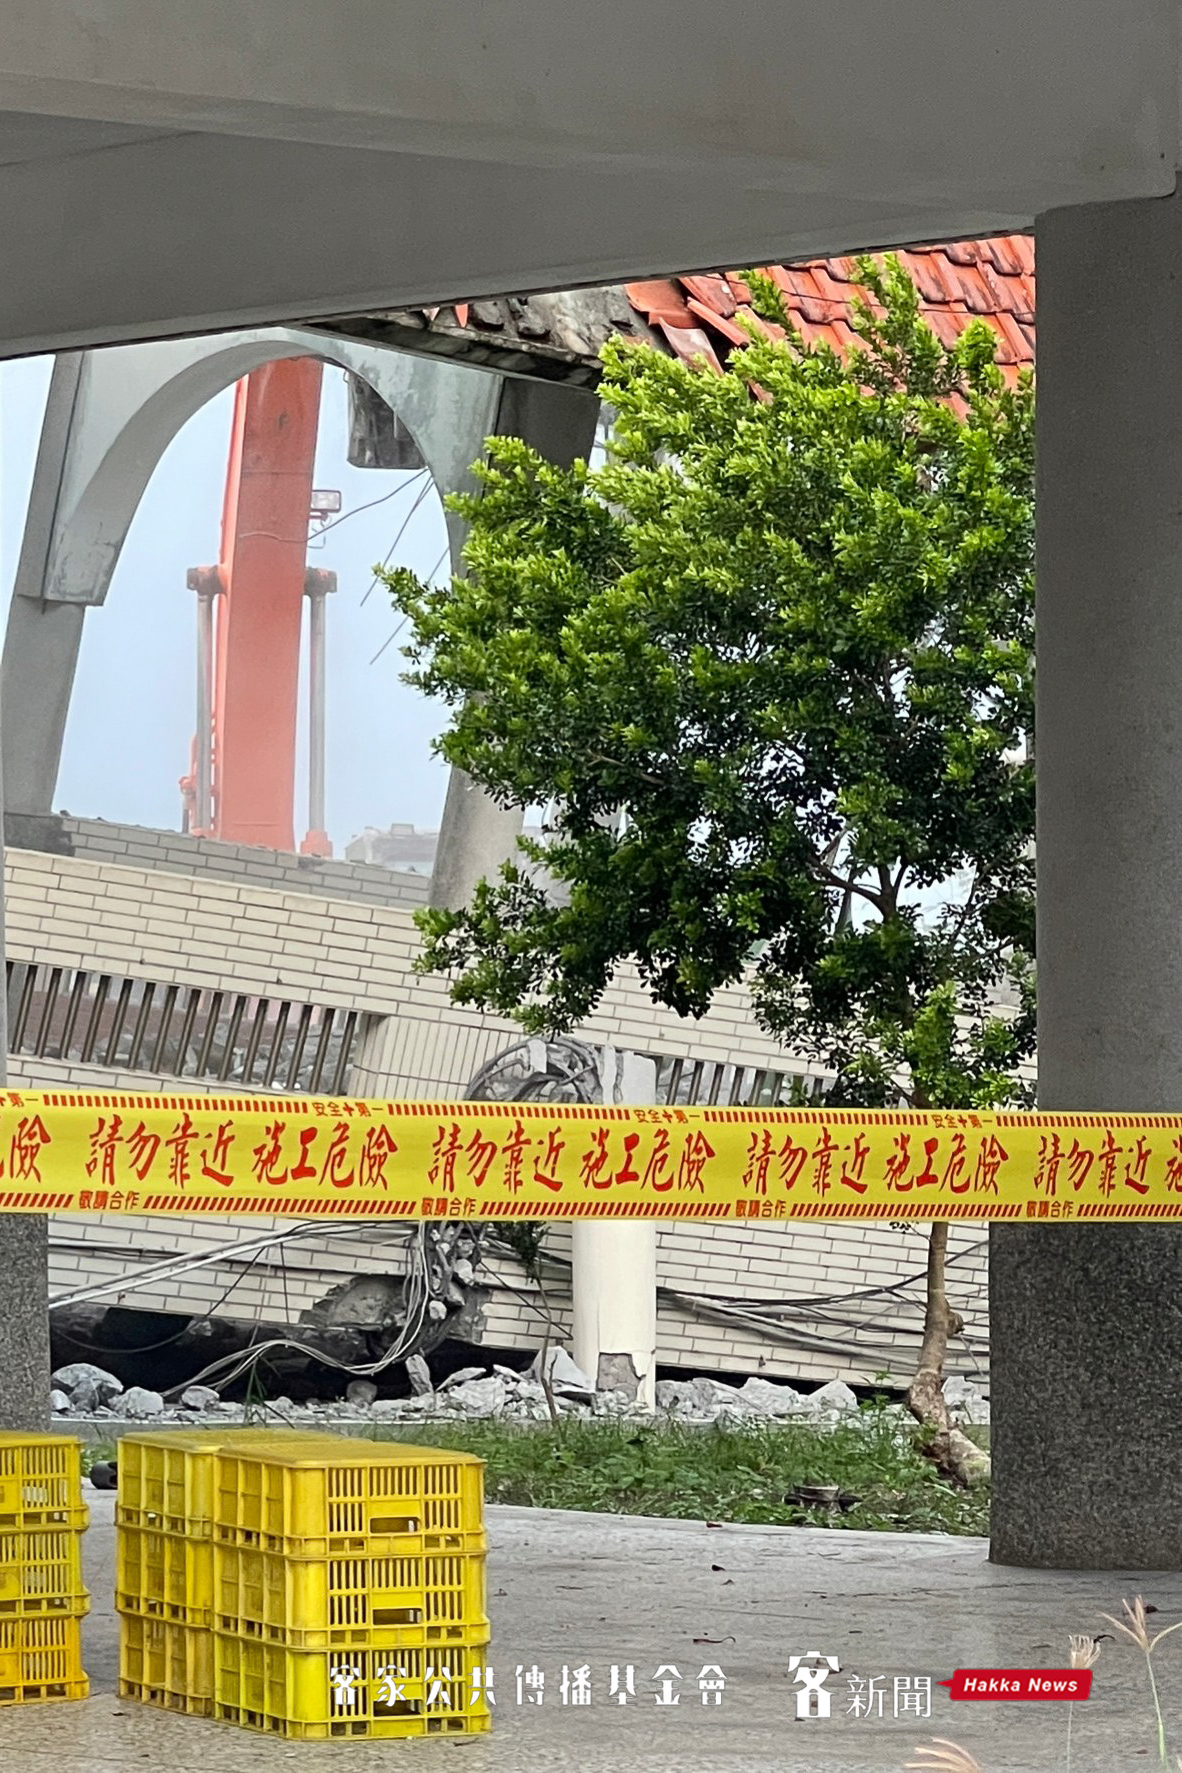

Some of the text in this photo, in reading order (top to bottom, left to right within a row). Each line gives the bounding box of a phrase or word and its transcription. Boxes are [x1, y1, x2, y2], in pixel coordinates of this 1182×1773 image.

[84, 1112, 399, 1191] 請勿靠近 施工危險
[427, 1118, 716, 1194] 請勿靠近 施工危險
[742, 1127, 1010, 1196] 請勿靠近 施工危險
[1033, 1130, 1151, 1196] 請勿靠近
[78, 1190, 140, 1211] 敬請合作
